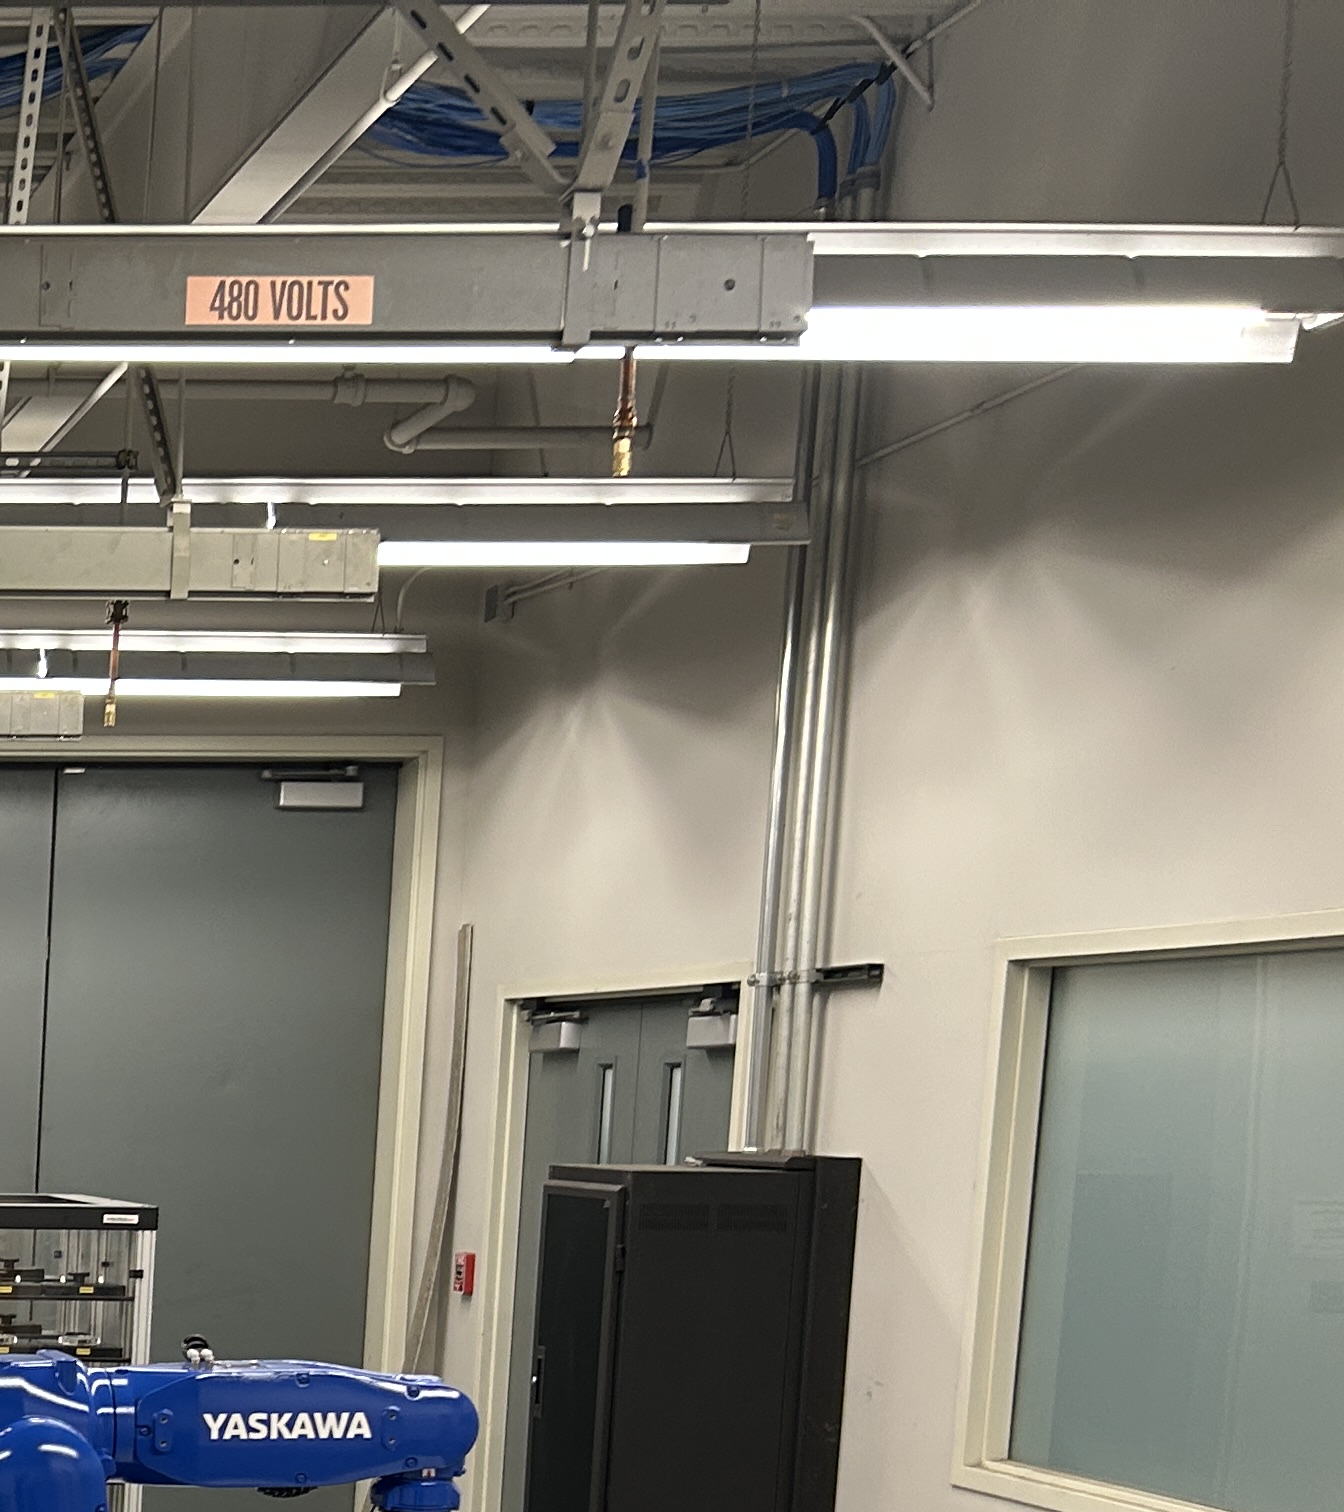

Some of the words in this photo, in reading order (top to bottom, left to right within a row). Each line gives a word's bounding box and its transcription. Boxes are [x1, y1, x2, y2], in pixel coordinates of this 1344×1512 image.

[209, 280, 259, 321] 480
[270, 280, 349, 321] VOLTS
[202, 1412, 373, 1441] YASKAWA
